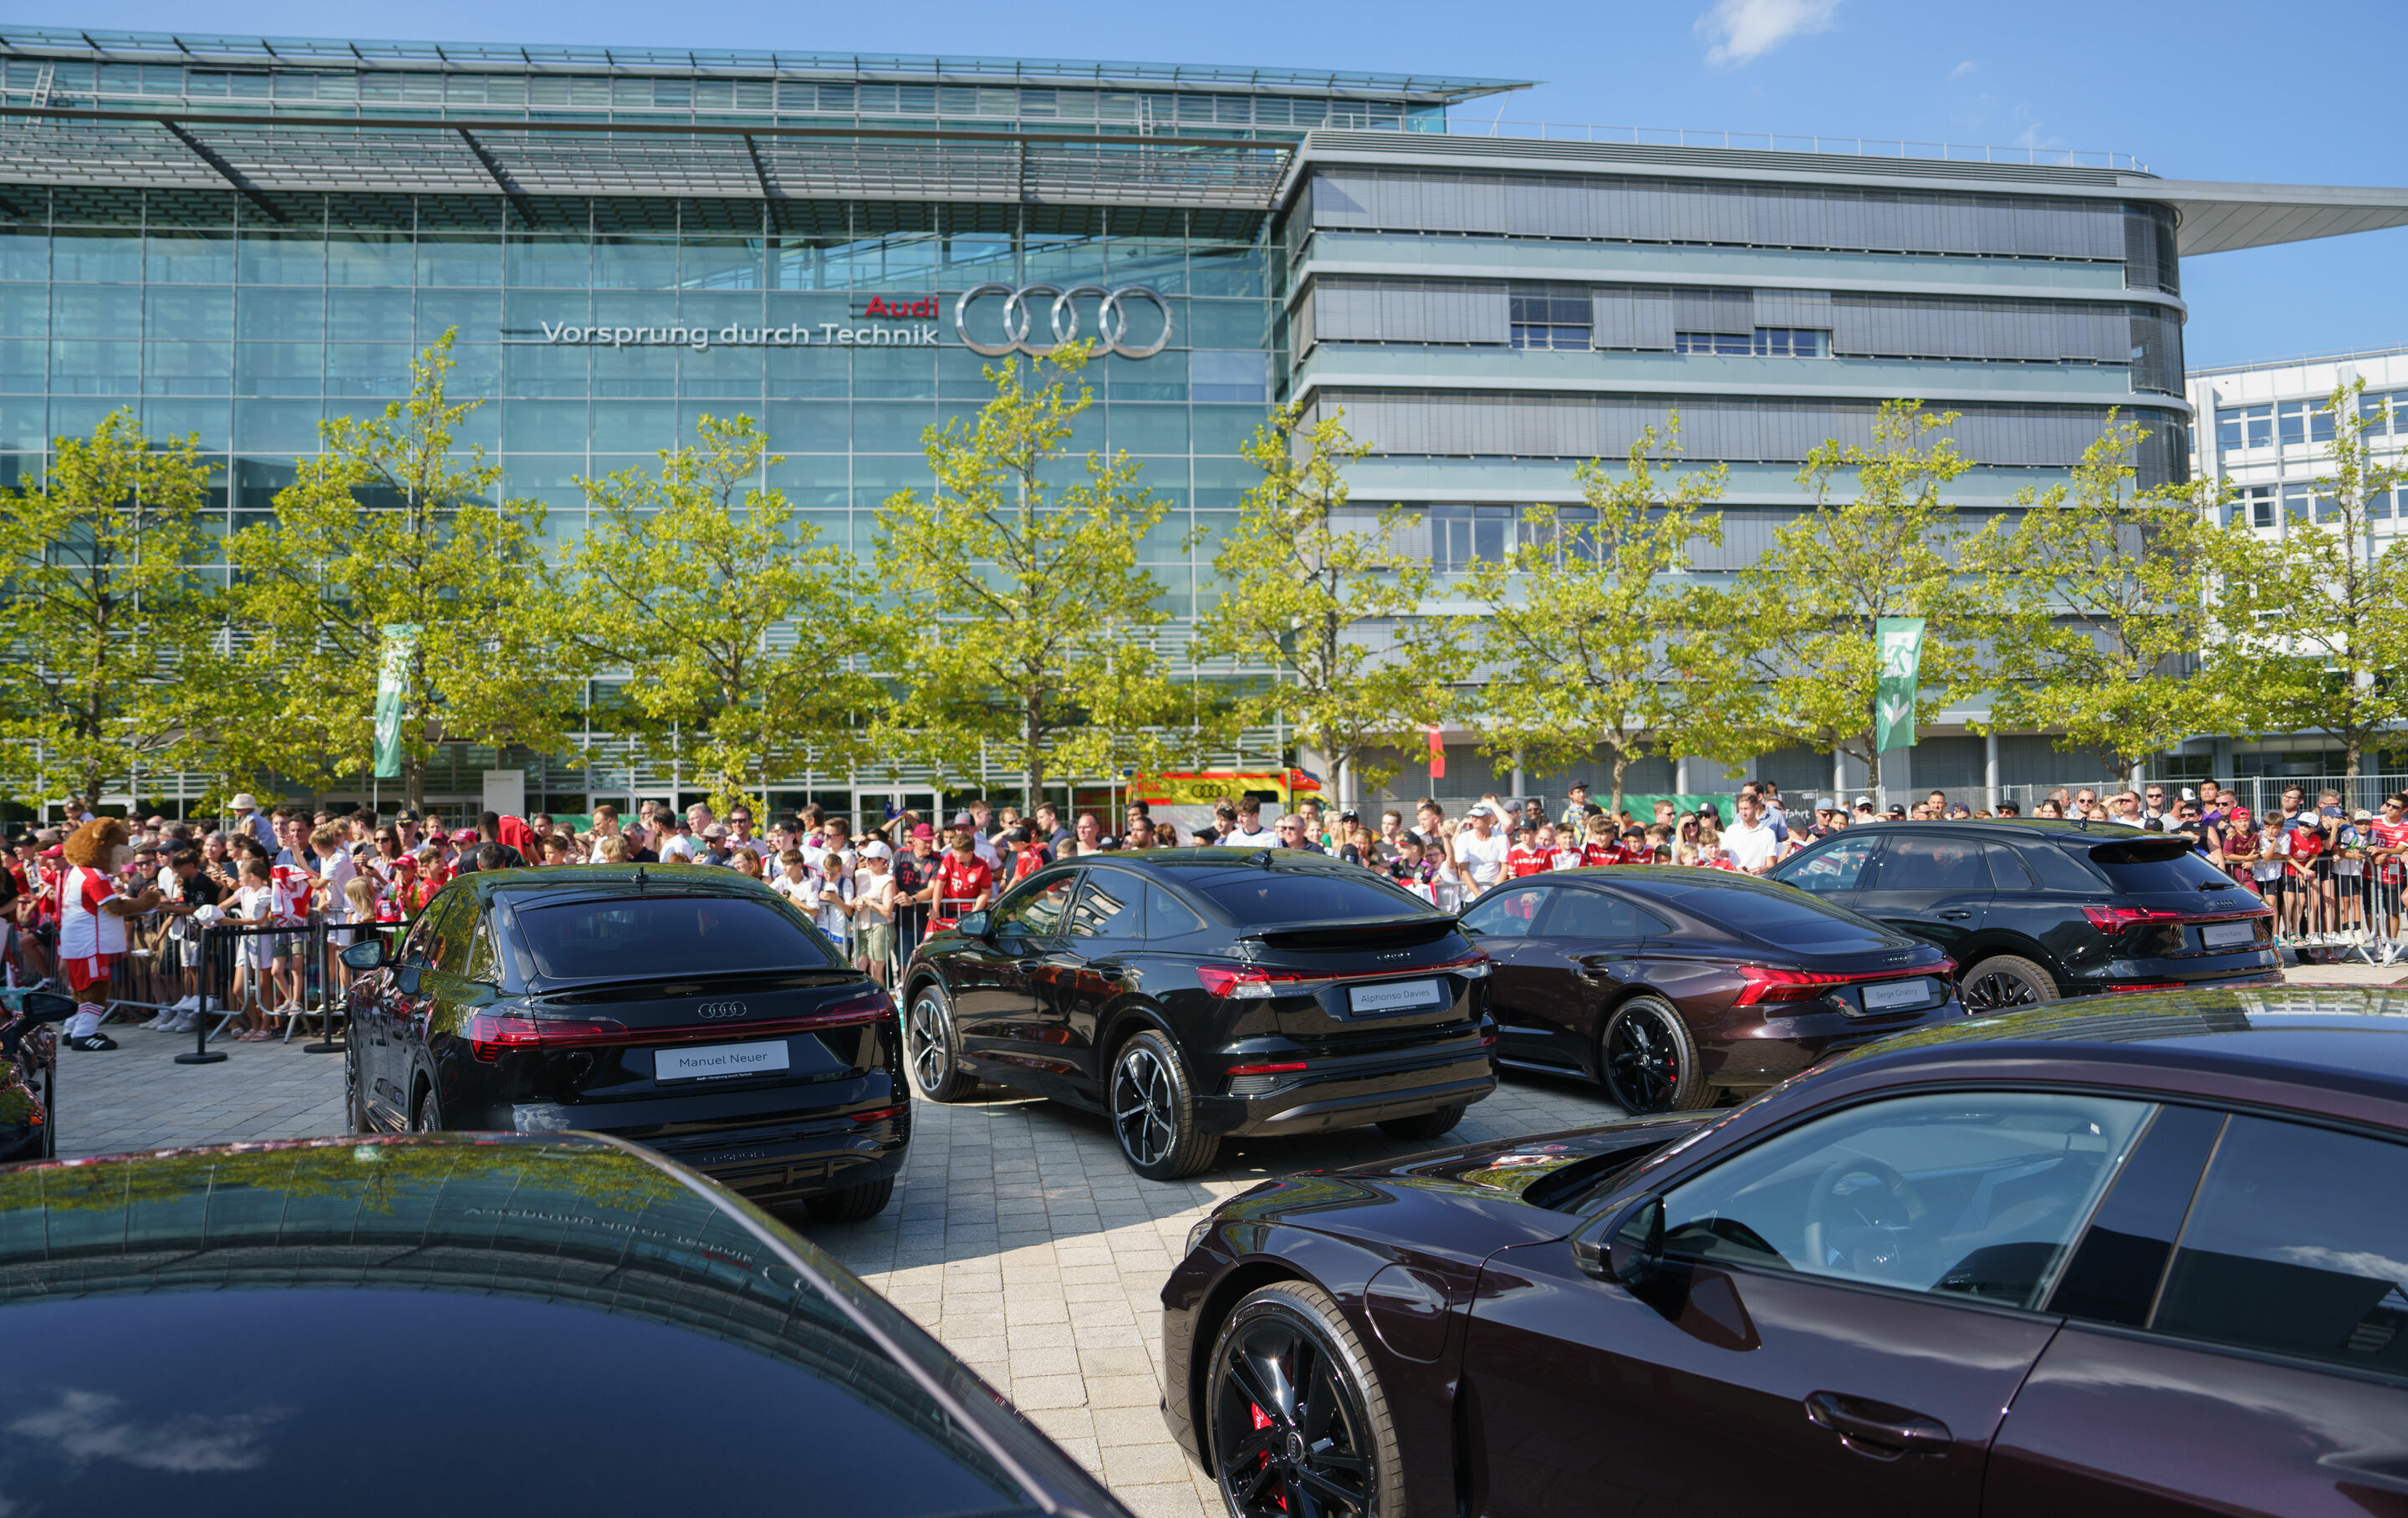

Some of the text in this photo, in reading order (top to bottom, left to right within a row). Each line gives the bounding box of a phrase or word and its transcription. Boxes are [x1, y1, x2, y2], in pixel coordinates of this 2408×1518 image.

[865, 296, 940, 318] Audi
[542, 321, 939, 349] Vorsprung durch Technik
[1361, 990, 1431, 1003] Alphonso Davies
[1895, 988, 1918, 996] Gnabry
[679, 1053, 768, 1068] Manuel Neuer
